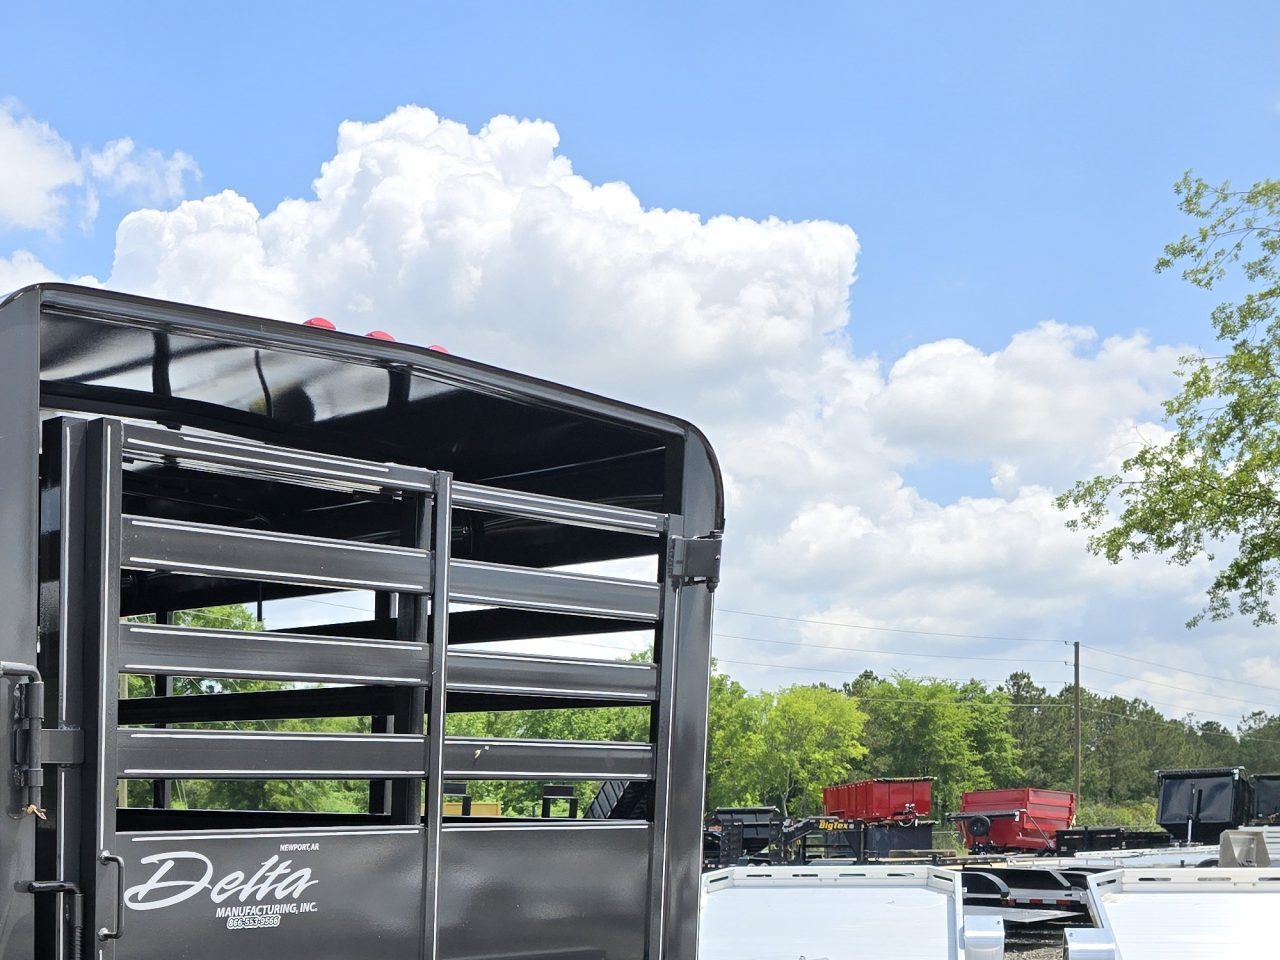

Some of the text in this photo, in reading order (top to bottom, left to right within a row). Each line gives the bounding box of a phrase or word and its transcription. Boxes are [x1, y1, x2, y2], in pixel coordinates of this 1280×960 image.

[123, 851, 319, 911] Delta
[215, 901, 318, 918] MANUFACTURING, INC.
[227, 915, 281, 930] 866-553-9566
